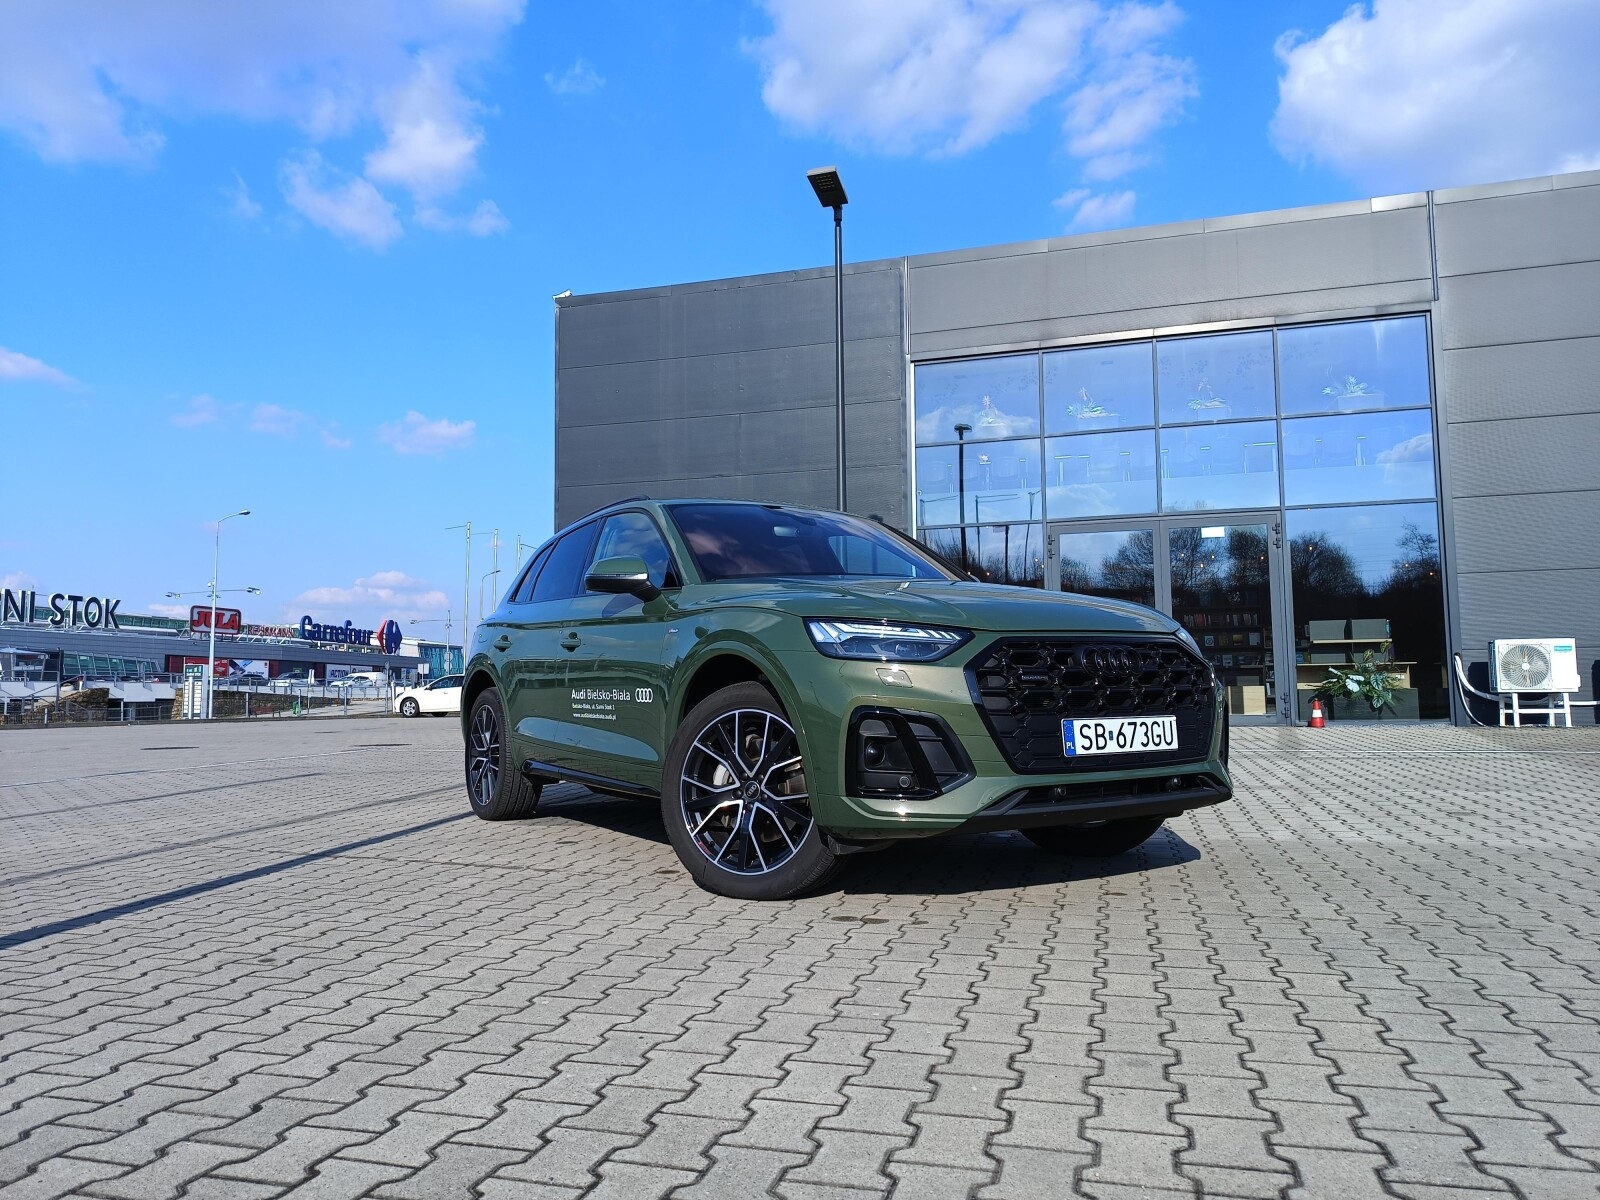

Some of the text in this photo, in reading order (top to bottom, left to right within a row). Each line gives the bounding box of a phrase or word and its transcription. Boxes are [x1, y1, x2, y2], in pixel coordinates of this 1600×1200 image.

[1, 588, 121, 629] NI STOK
[193, 611, 239, 630] JULA
[300, 615, 373, 646] Carrefour
[571, 689, 586, 699] Audi
[1066, 742, 1075, 750] PL
